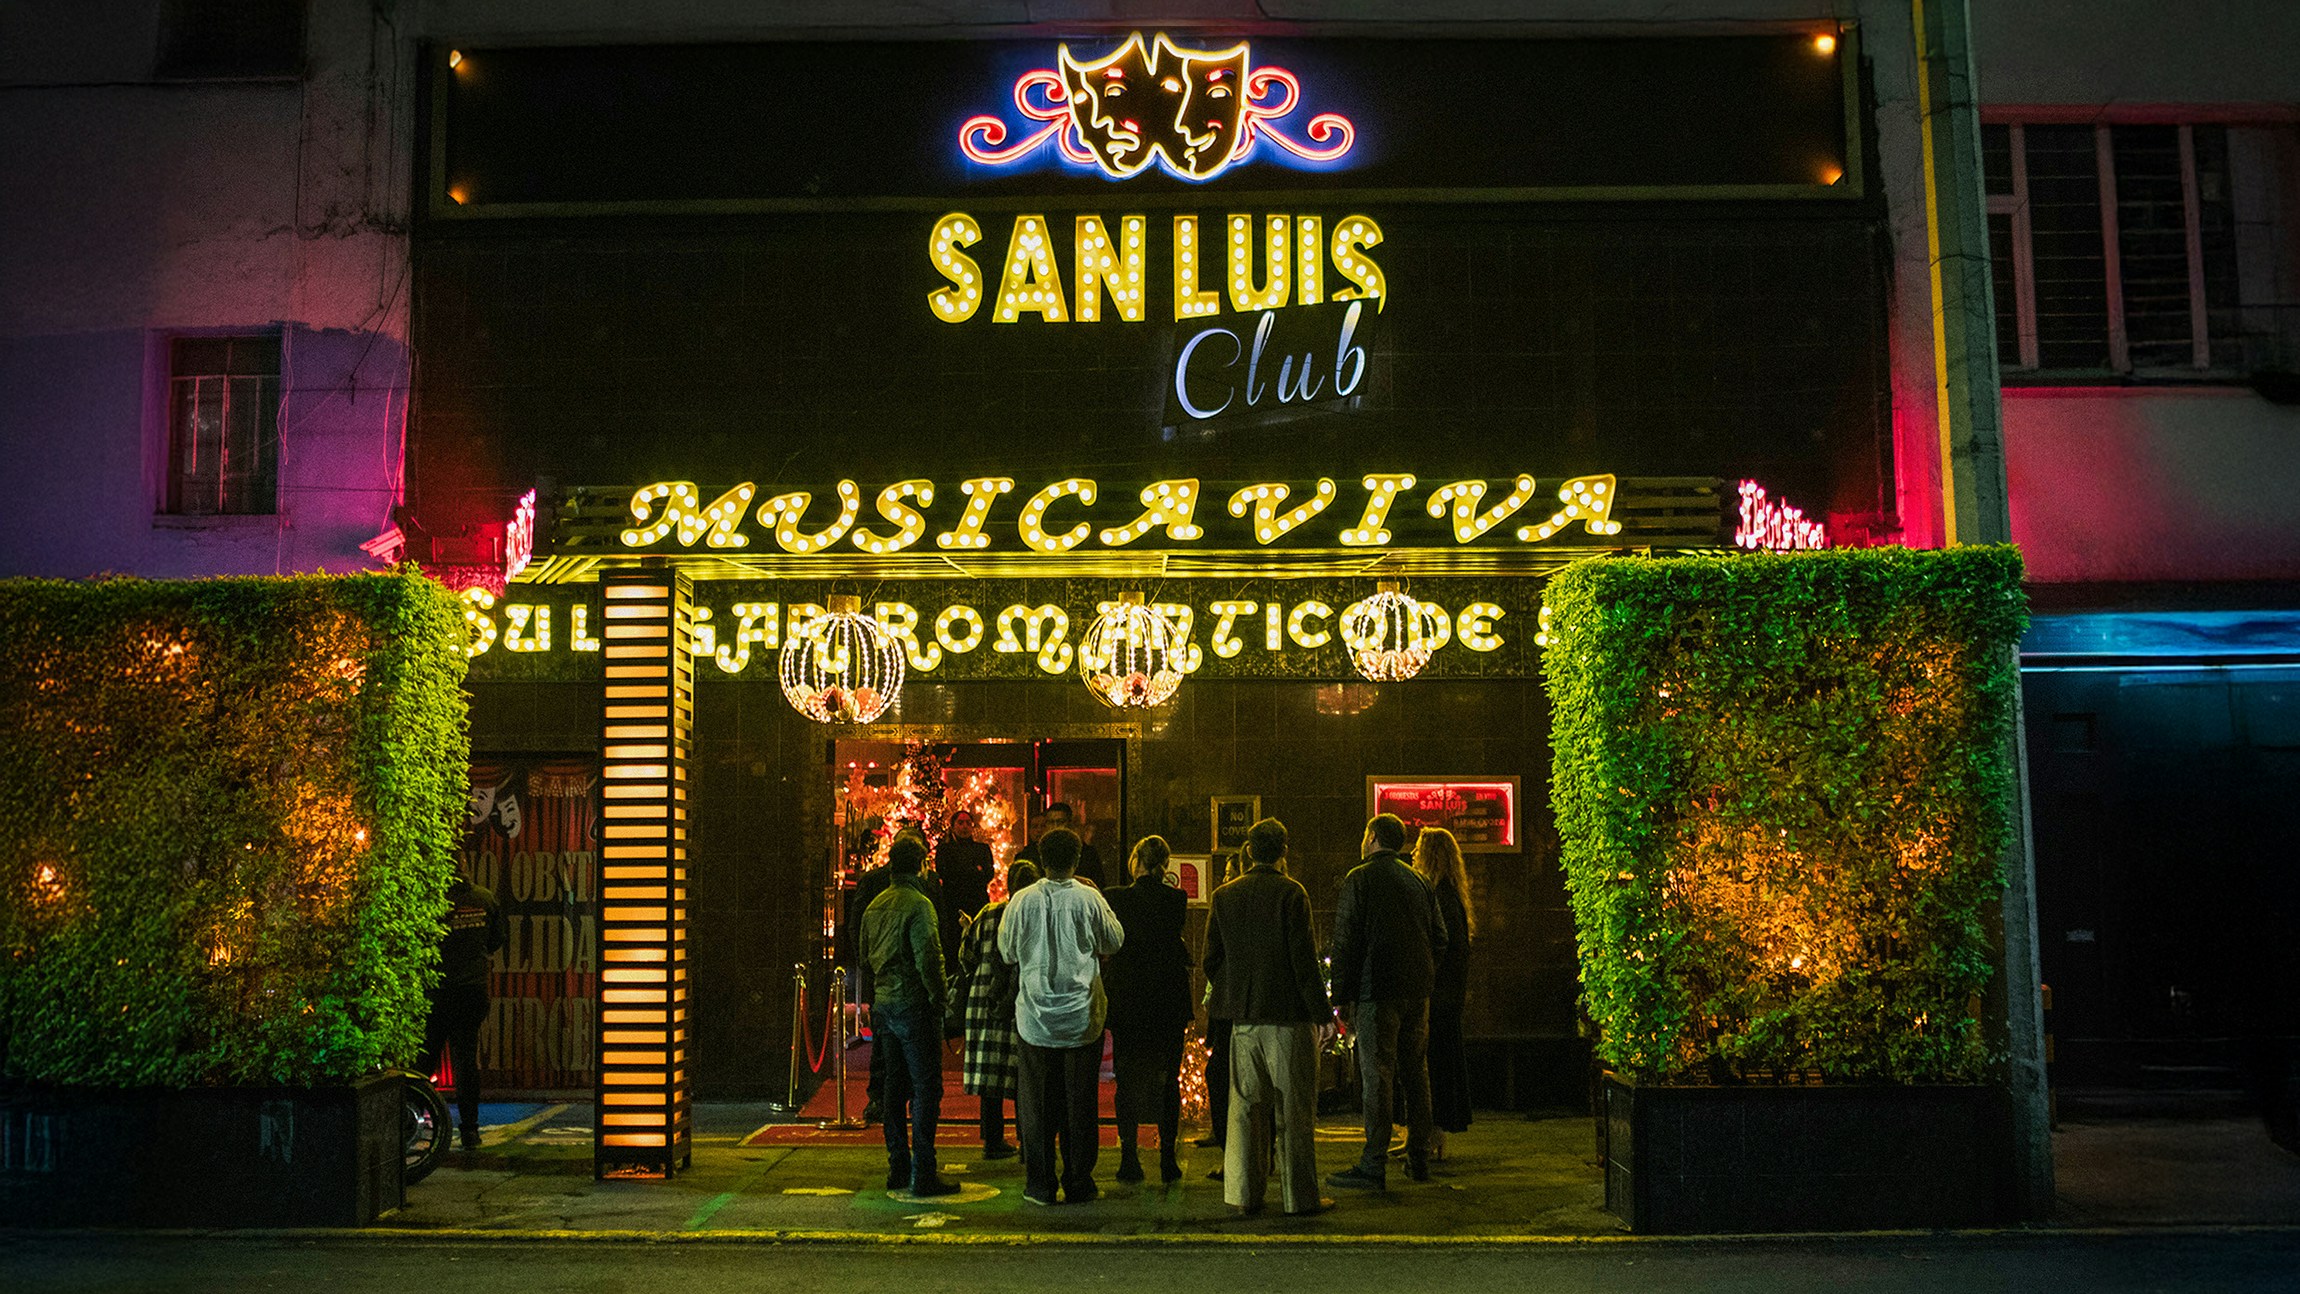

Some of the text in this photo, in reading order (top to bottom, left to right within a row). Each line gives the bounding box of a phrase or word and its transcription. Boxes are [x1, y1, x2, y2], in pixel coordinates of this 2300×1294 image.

[927, 212, 1386, 323] SAN LUIS
[1175, 301, 1366, 419] Club
[620, 478, 1203, 554] MUSICA
[1228, 473, 1622, 545] VIVA
[462, 586, 551, 657] SU
[571, 602, 849, 674] LGAR
[875, 601, 1388, 674] ROMANTICO
[1408, 602, 1507, 652] DE
[1221, 825, 1249, 836] COVE
[1230, 811, 1244, 822] NO
[1420, 800, 1443, 811] SAN
[511, 850, 597, 903] OBST
